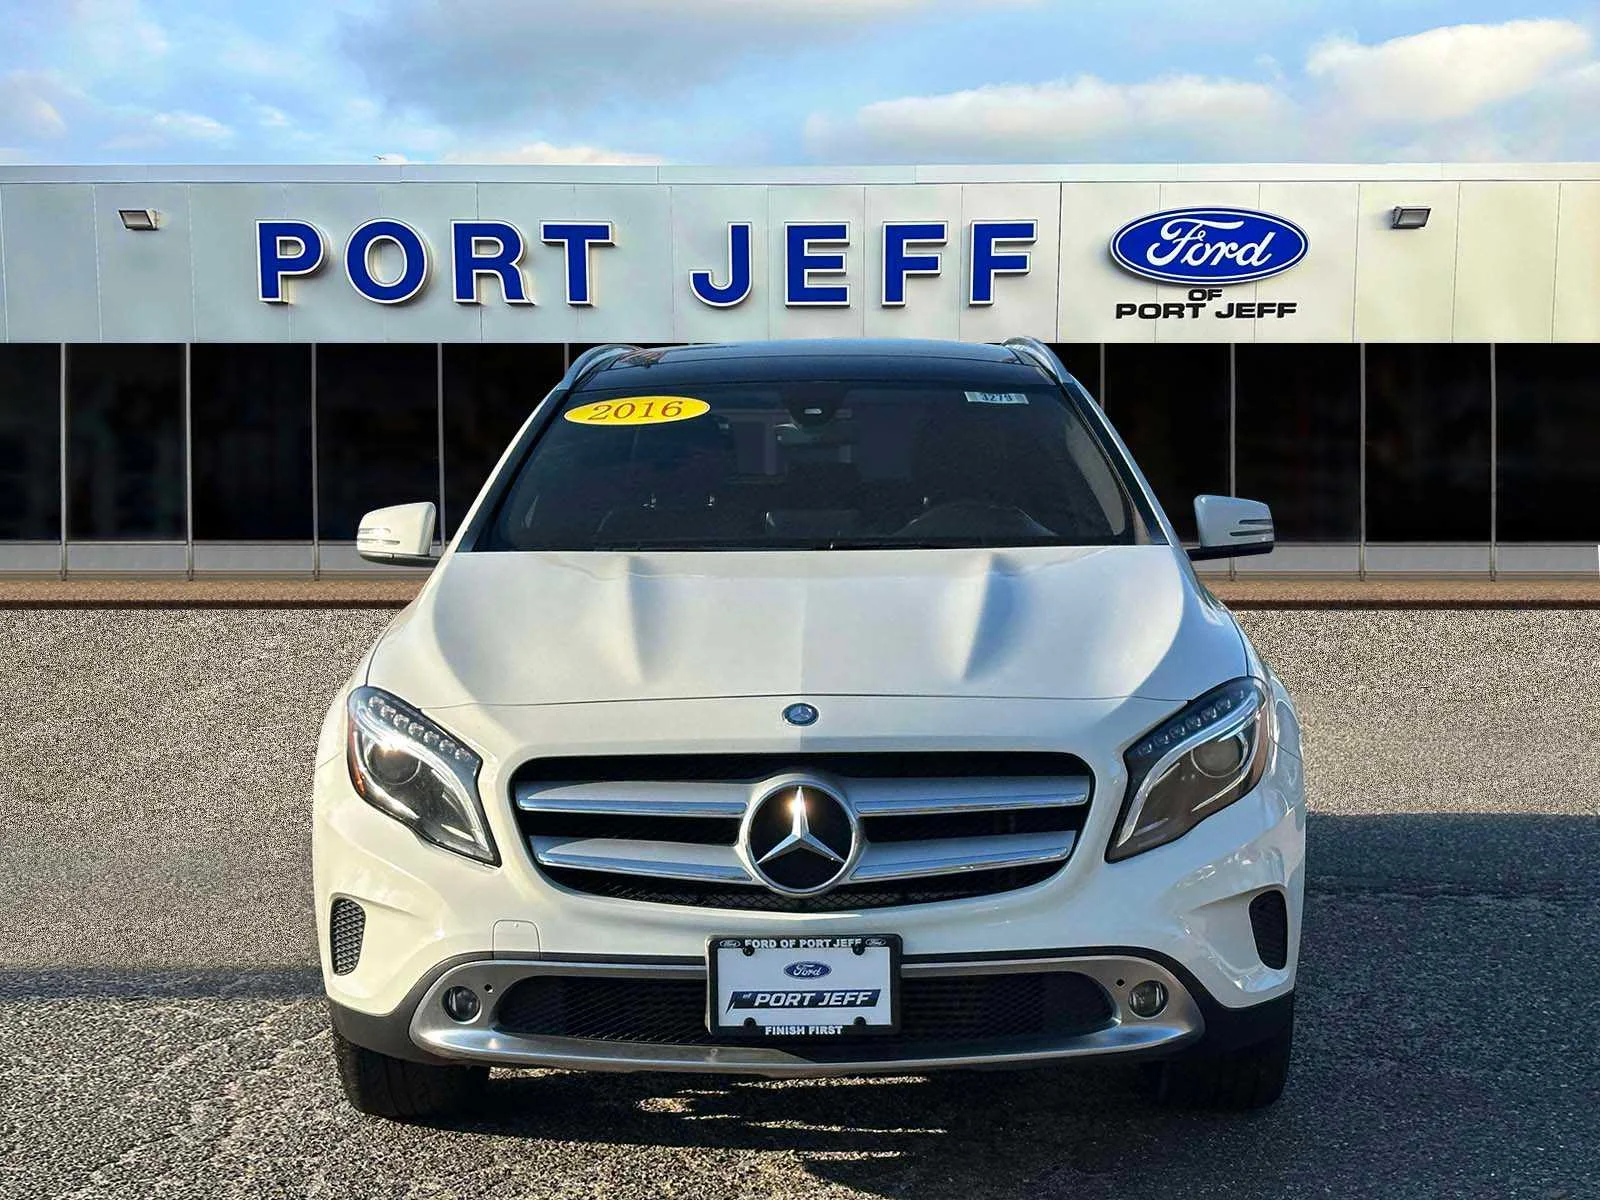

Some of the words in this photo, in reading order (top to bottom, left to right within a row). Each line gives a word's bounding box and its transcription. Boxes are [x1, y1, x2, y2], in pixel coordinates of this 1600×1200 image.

[1146, 218, 1276, 267] Ford
[255, 218, 614, 305] PORT
[689, 219, 1038, 307] JEFF
[1188, 288, 1223, 302] OF
[1115, 302, 1207, 319] PORT
[1215, 302, 1297, 319] JEFF
[587, 400, 684, 421] 2016
[744, 939, 777, 948] FORD
[780, 939, 796, 948] OF
[800, 939, 832, 948] PORT
[833, 938, 862, 948] JEFF
[793, 963, 822, 976] Ford
[754, 992, 816, 1007] PORT
[817, 991, 873, 1007] JEFF
[765, 1026, 805, 1036] FINISH
[808, 1025, 843, 1035] FIRST
